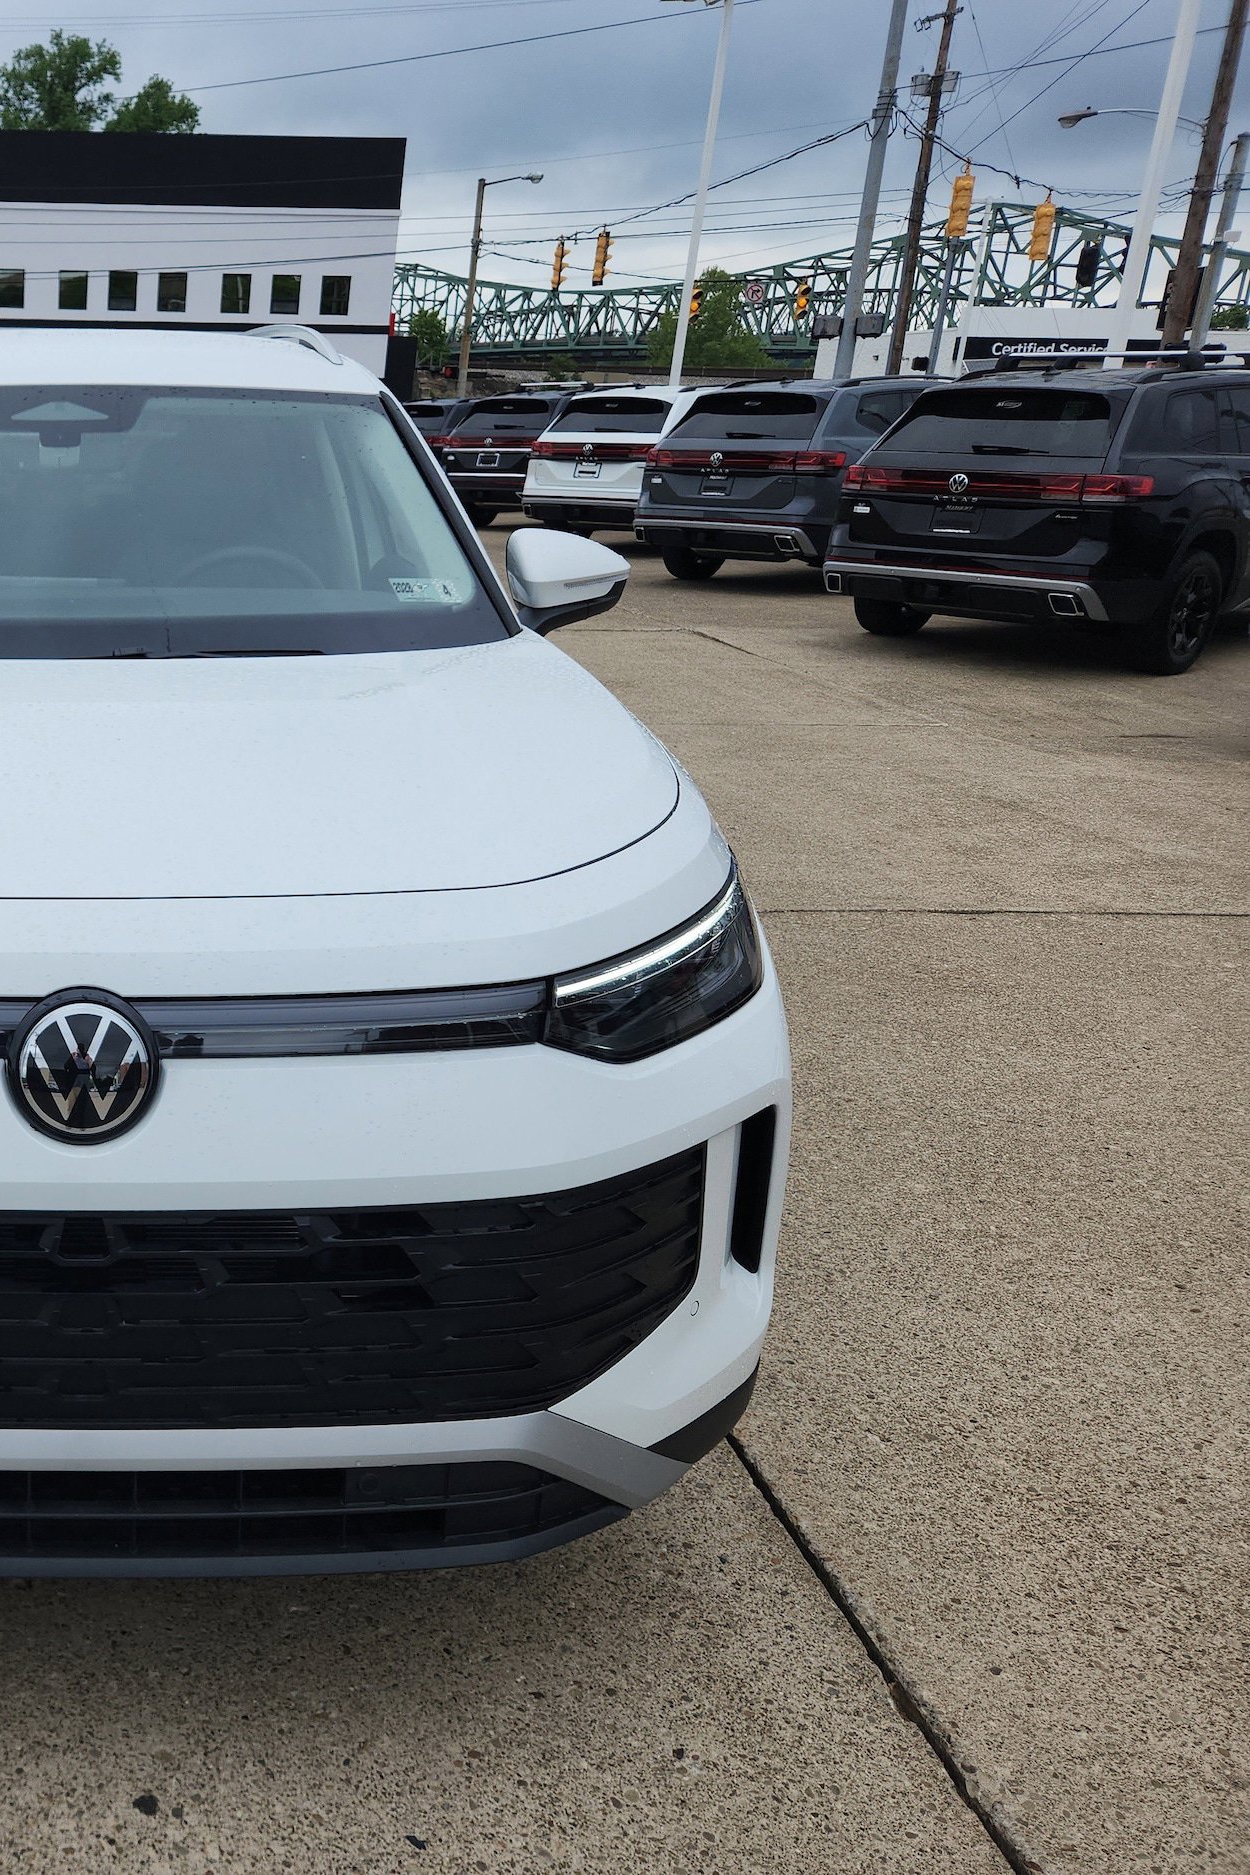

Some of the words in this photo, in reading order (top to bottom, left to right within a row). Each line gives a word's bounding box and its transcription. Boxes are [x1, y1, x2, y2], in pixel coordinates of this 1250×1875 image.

[991, 342, 1054, 356] Certified
[949, 473, 969, 493] VW
[19, 1002, 149, 1135] VW
